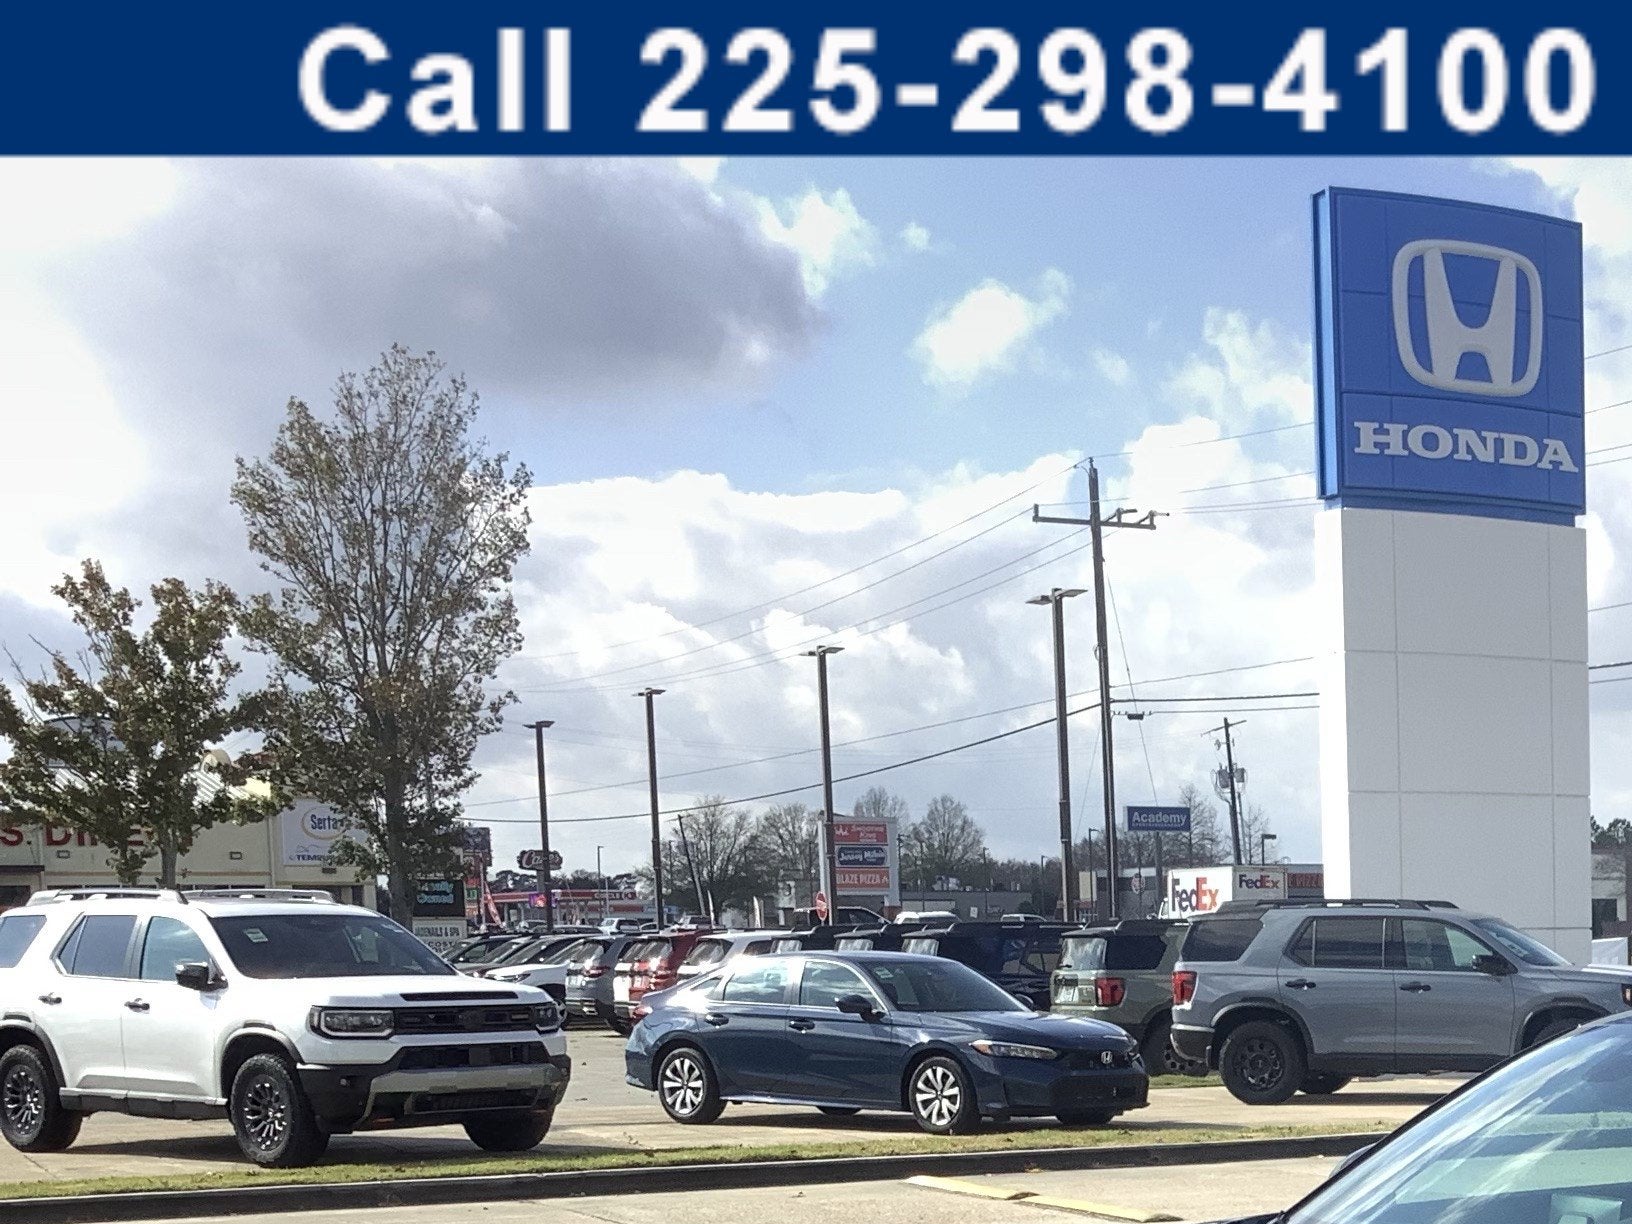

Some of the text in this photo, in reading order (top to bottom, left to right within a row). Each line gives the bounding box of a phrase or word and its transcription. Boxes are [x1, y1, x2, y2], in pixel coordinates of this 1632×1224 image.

[1353, 421, 1579, 473] HONDA
[310, 814, 338, 830] Serta
[1132, 811, 1187, 827] Academy
[860, 873, 881, 884] PIZZA
[1239, 873, 1280, 889] FedEx
[1171, 876, 1220, 912] FedEx
